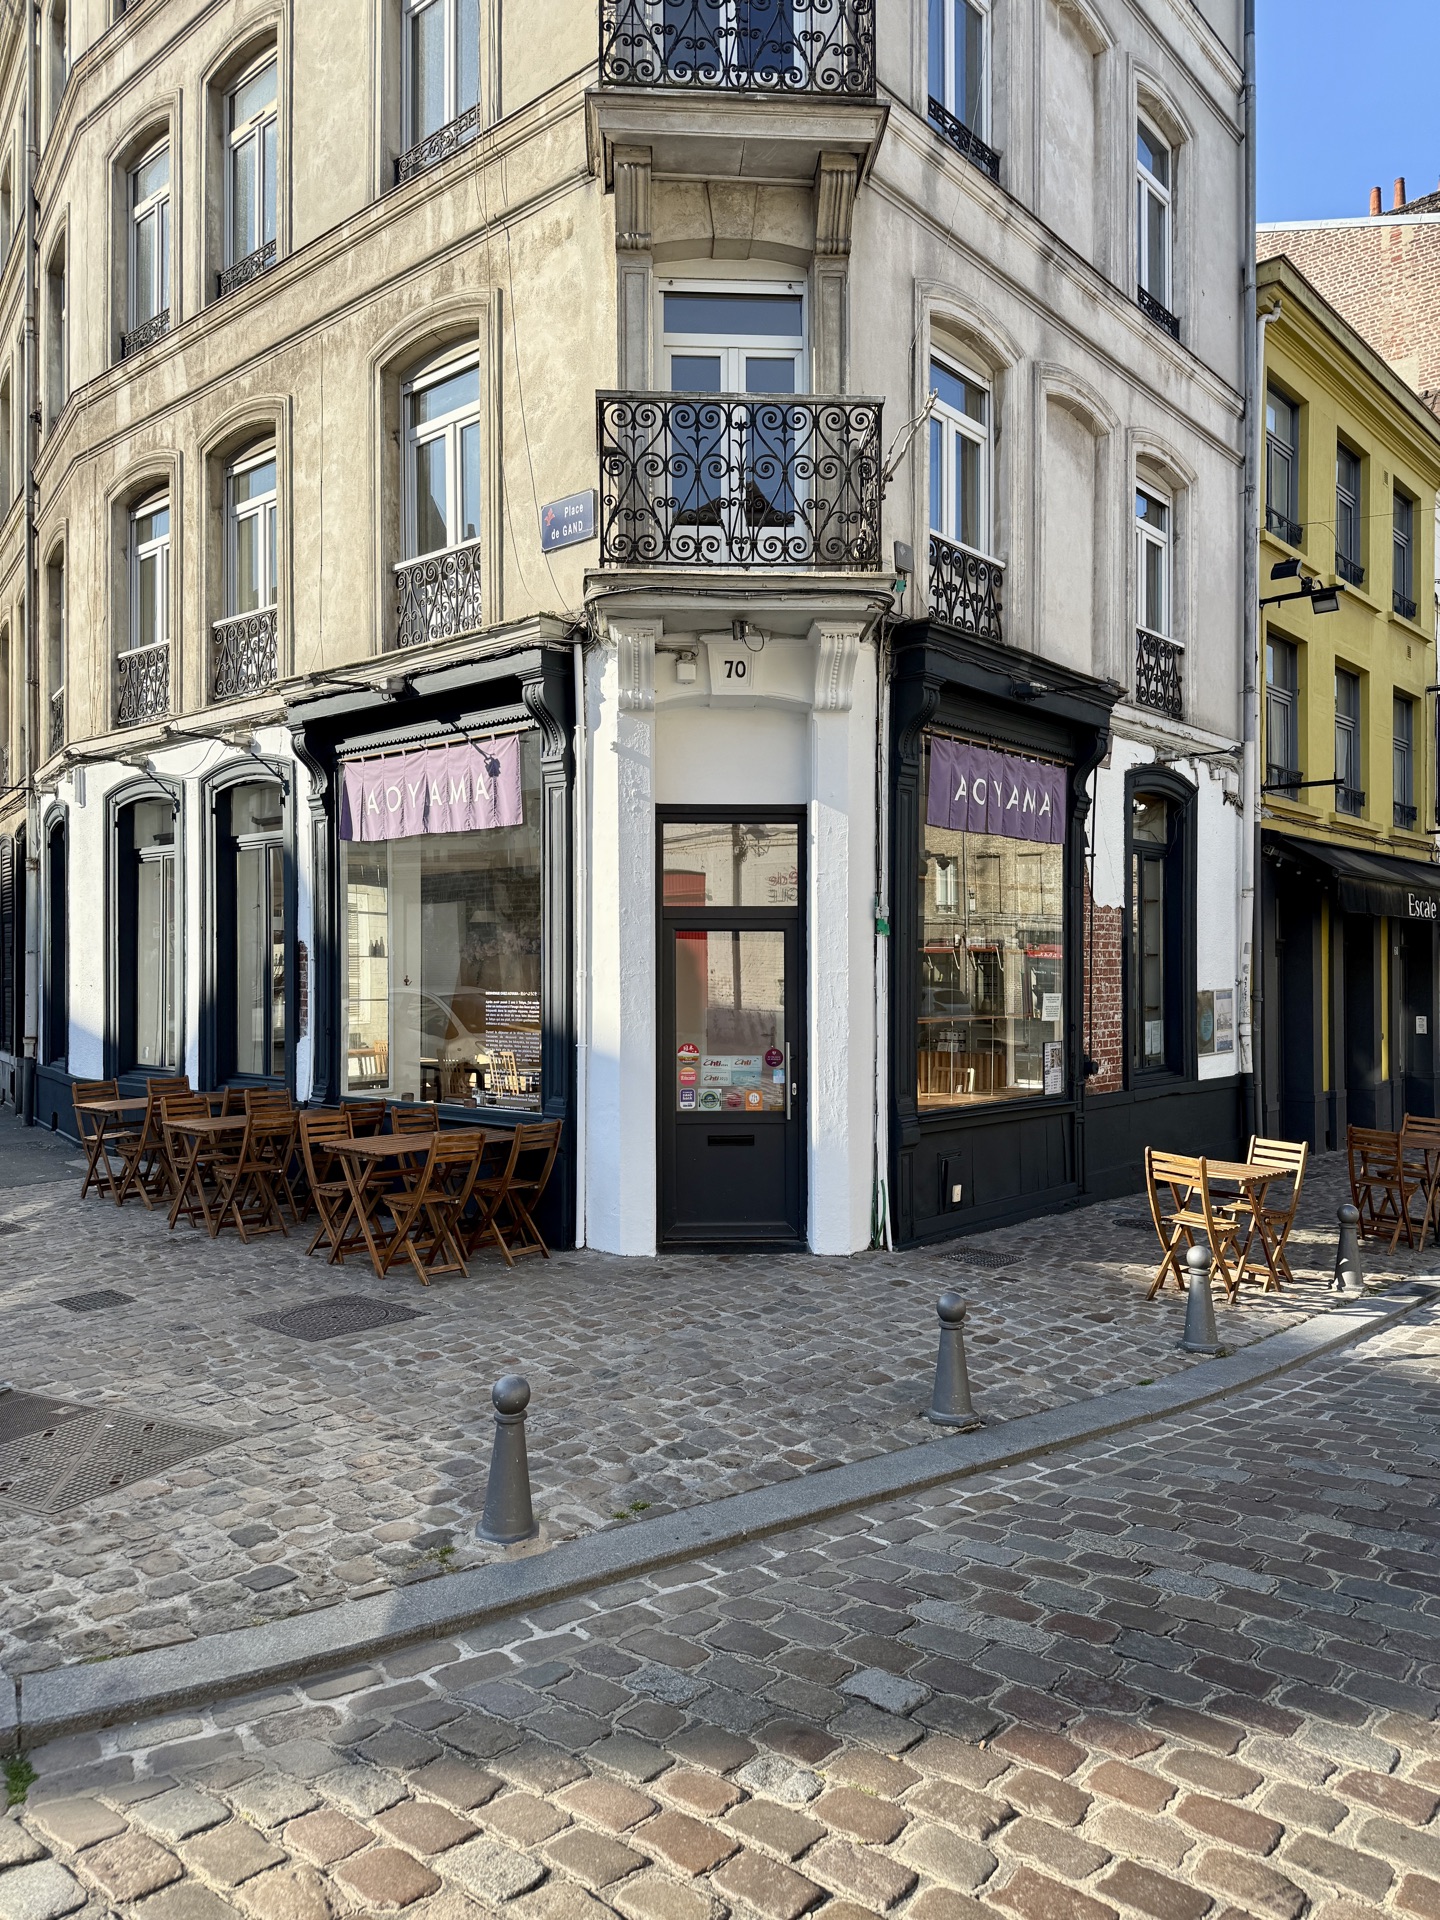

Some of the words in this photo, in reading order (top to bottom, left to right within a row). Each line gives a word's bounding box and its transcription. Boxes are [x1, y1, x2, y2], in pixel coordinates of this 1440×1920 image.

[564, 504, 584, 518] Place
[551, 528, 560, 540] de
[562, 520, 583, 537] GAND
[724, 660, 746, 678] 70
[366, 772, 490, 816] AOYAMA
[1407, 892, 1437, 919] Escale
